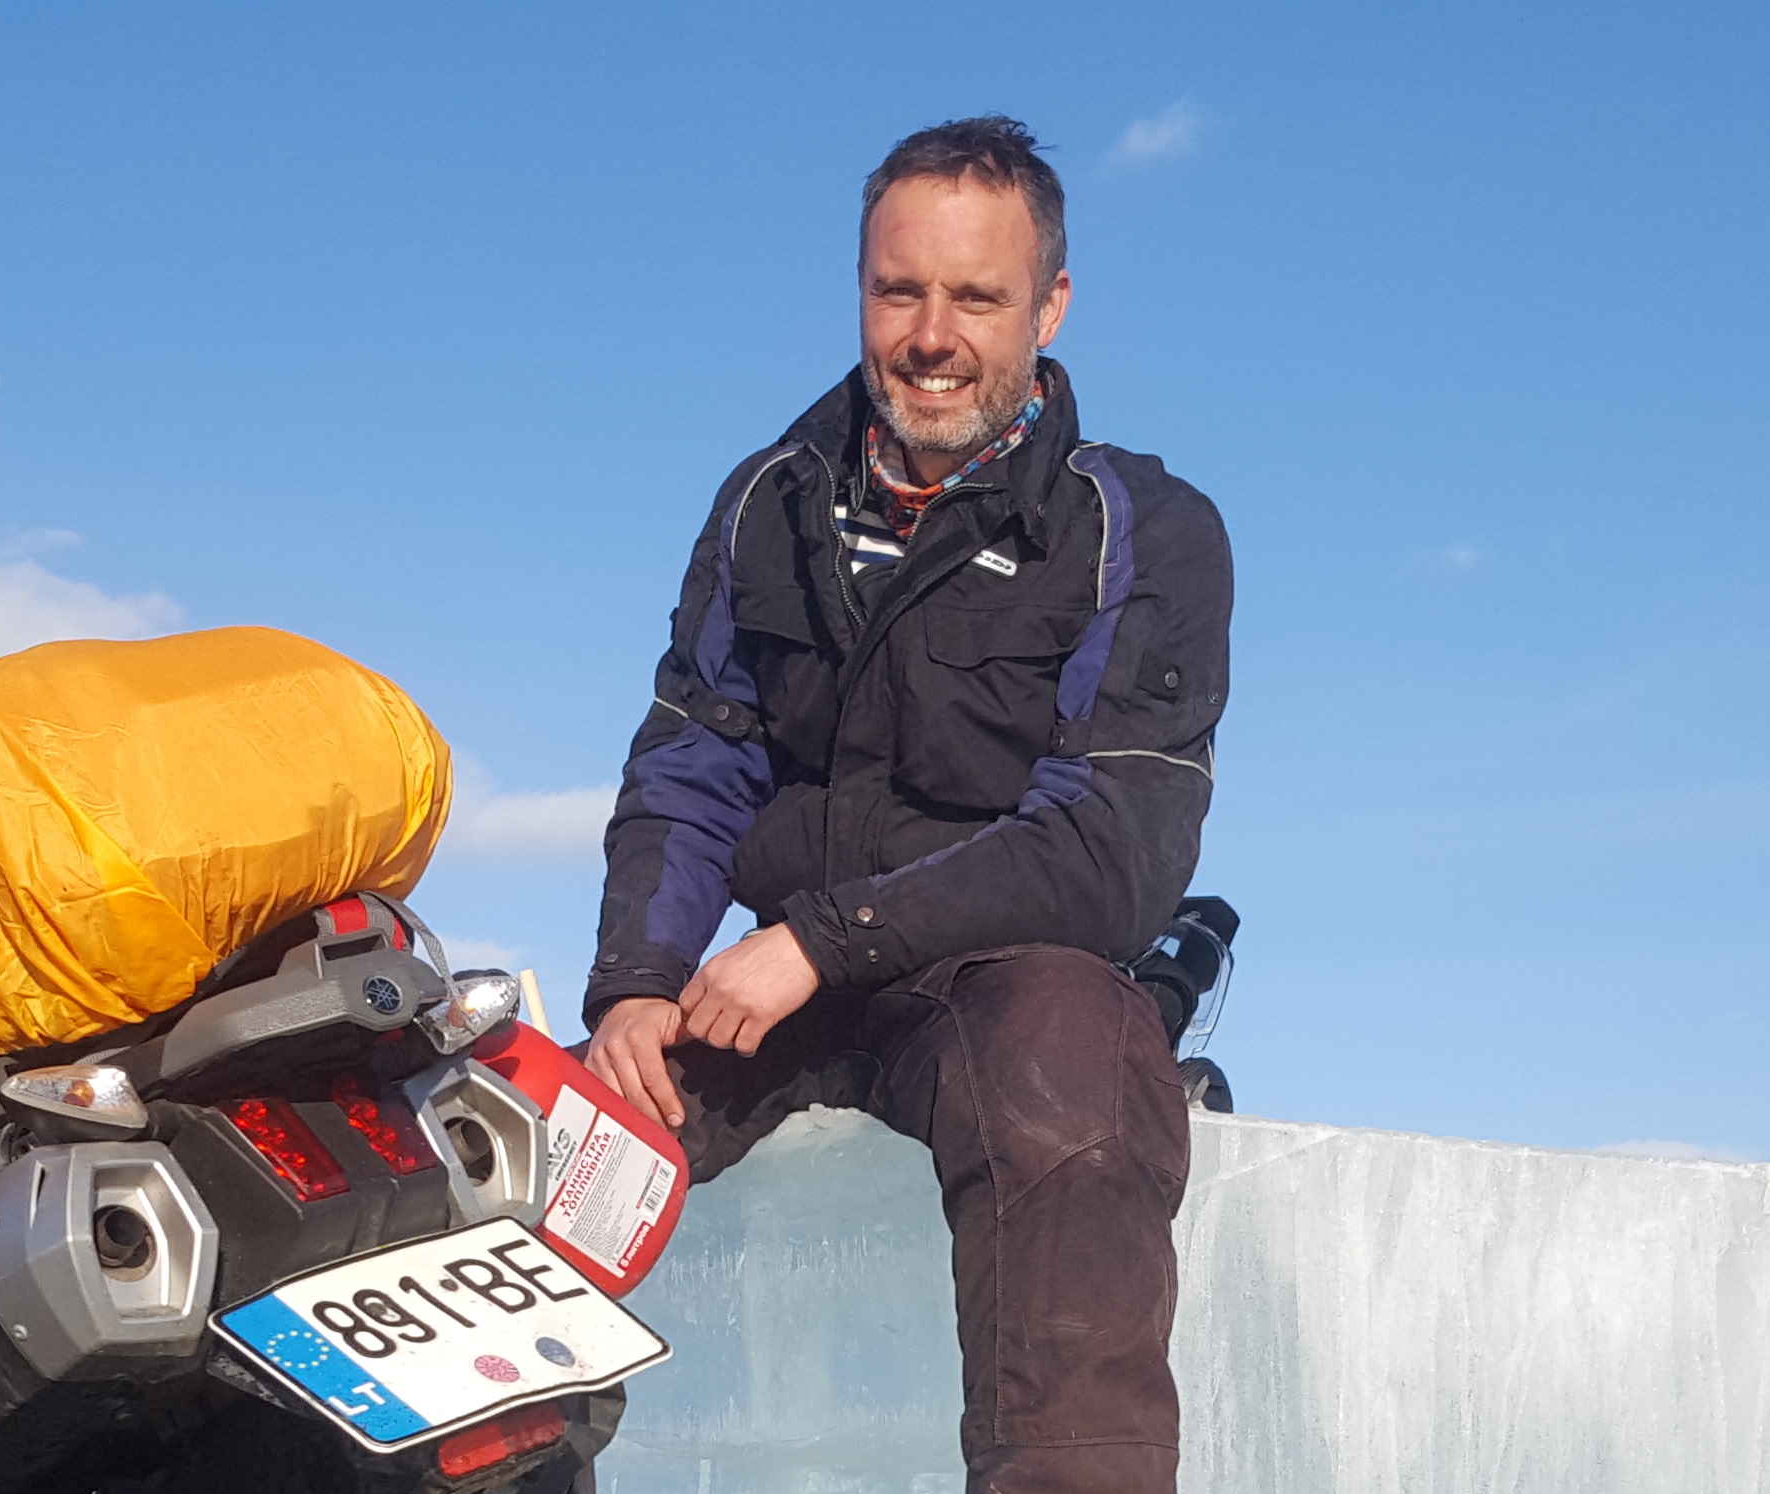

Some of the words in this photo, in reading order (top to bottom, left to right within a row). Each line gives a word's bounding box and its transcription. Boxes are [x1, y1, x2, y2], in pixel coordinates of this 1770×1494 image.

[559, 1134, 602, 1208] КАНИСТРА
[563, 1132, 611, 1217] ТОПЛИВНАЯ
[625, 1224, 650, 1261] литров
[312, 1276, 478, 1359] 891
[442, 1238, 590, 1314] BE
[328, 1381, 386, 1416] LT
